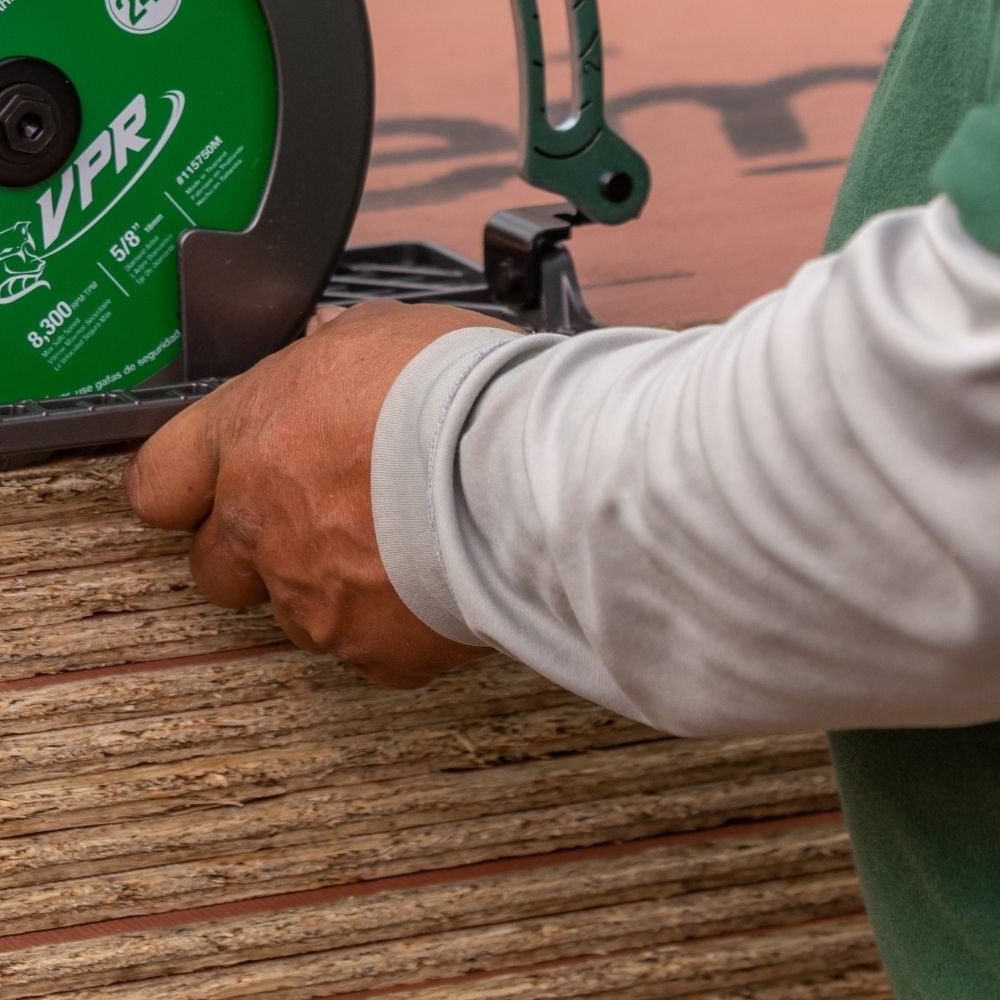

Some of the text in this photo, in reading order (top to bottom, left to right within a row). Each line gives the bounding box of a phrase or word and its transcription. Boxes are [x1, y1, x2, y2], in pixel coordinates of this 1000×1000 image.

[36, 93, 151, 250] VPR
[176, 135, 223, 186] #115750M
[27, 300, 73, 349] 8,300
[95, 370, 123, 391] gafas
[123, 363, 136, 375] de
[137, 328, 181, 367] seguridad
